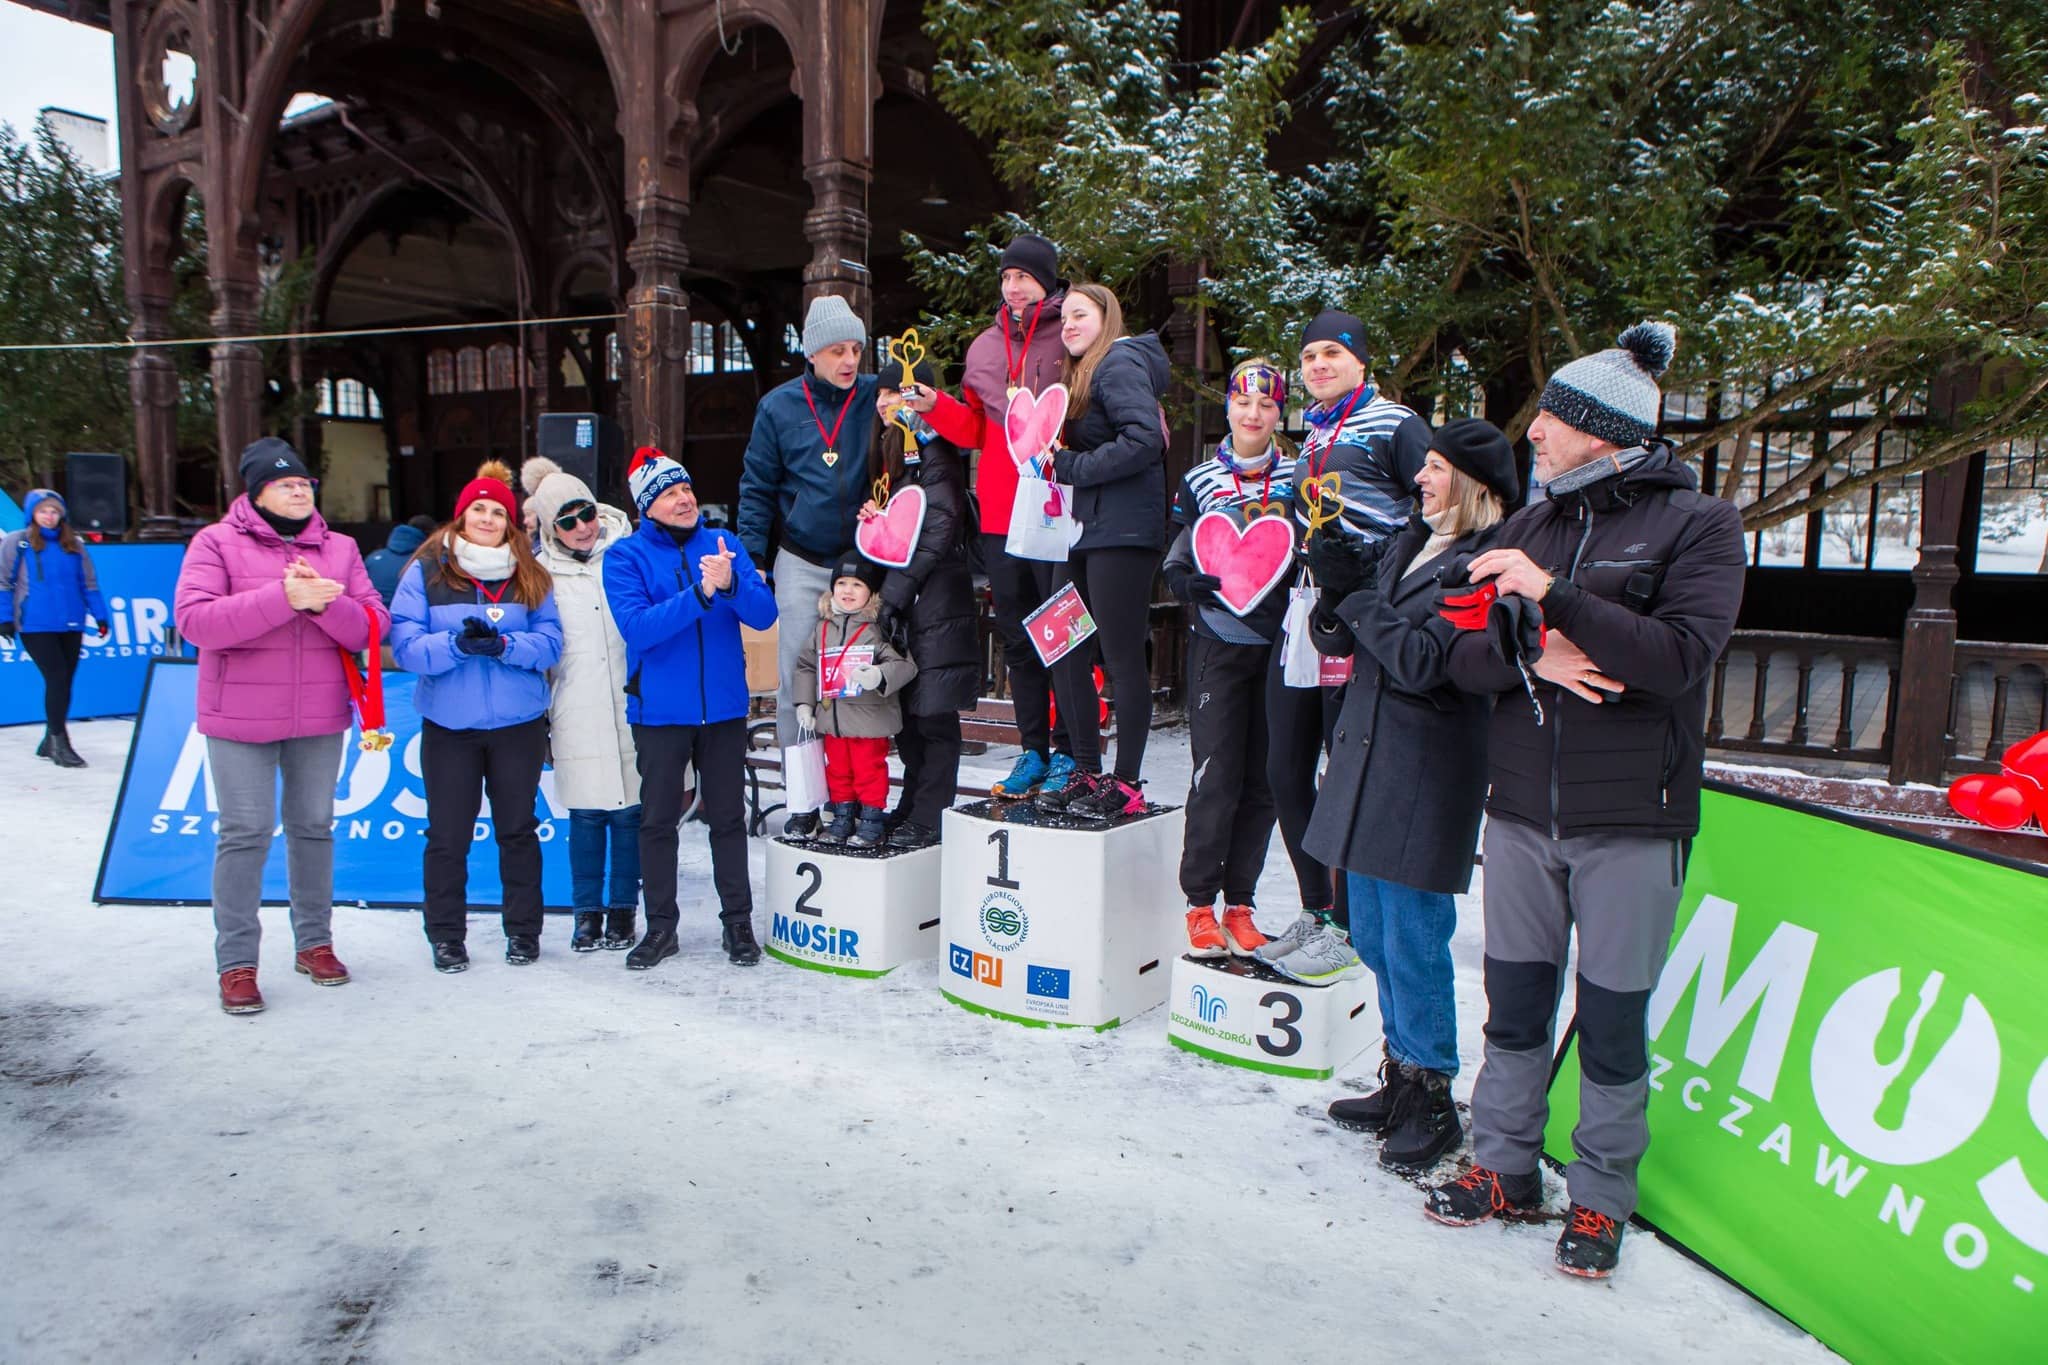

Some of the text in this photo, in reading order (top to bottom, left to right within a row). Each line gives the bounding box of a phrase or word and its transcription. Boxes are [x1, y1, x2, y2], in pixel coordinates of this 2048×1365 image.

[1043, 624, 1055, 641] 6
[987, 829, 1020, 890] 1
[795, 862, 823, 917] 2
[983, 891, 1025, 913] EUROREGION
[985, 935, 1021, 953] GLACENSIS
[1170, 1012, 1252, 1047] SZCZAWNO-ZDRÓJ
[1256, 991, 1303, 1057] 3
[1648, 1053, 2034, 1294] ZCZAWNO-
